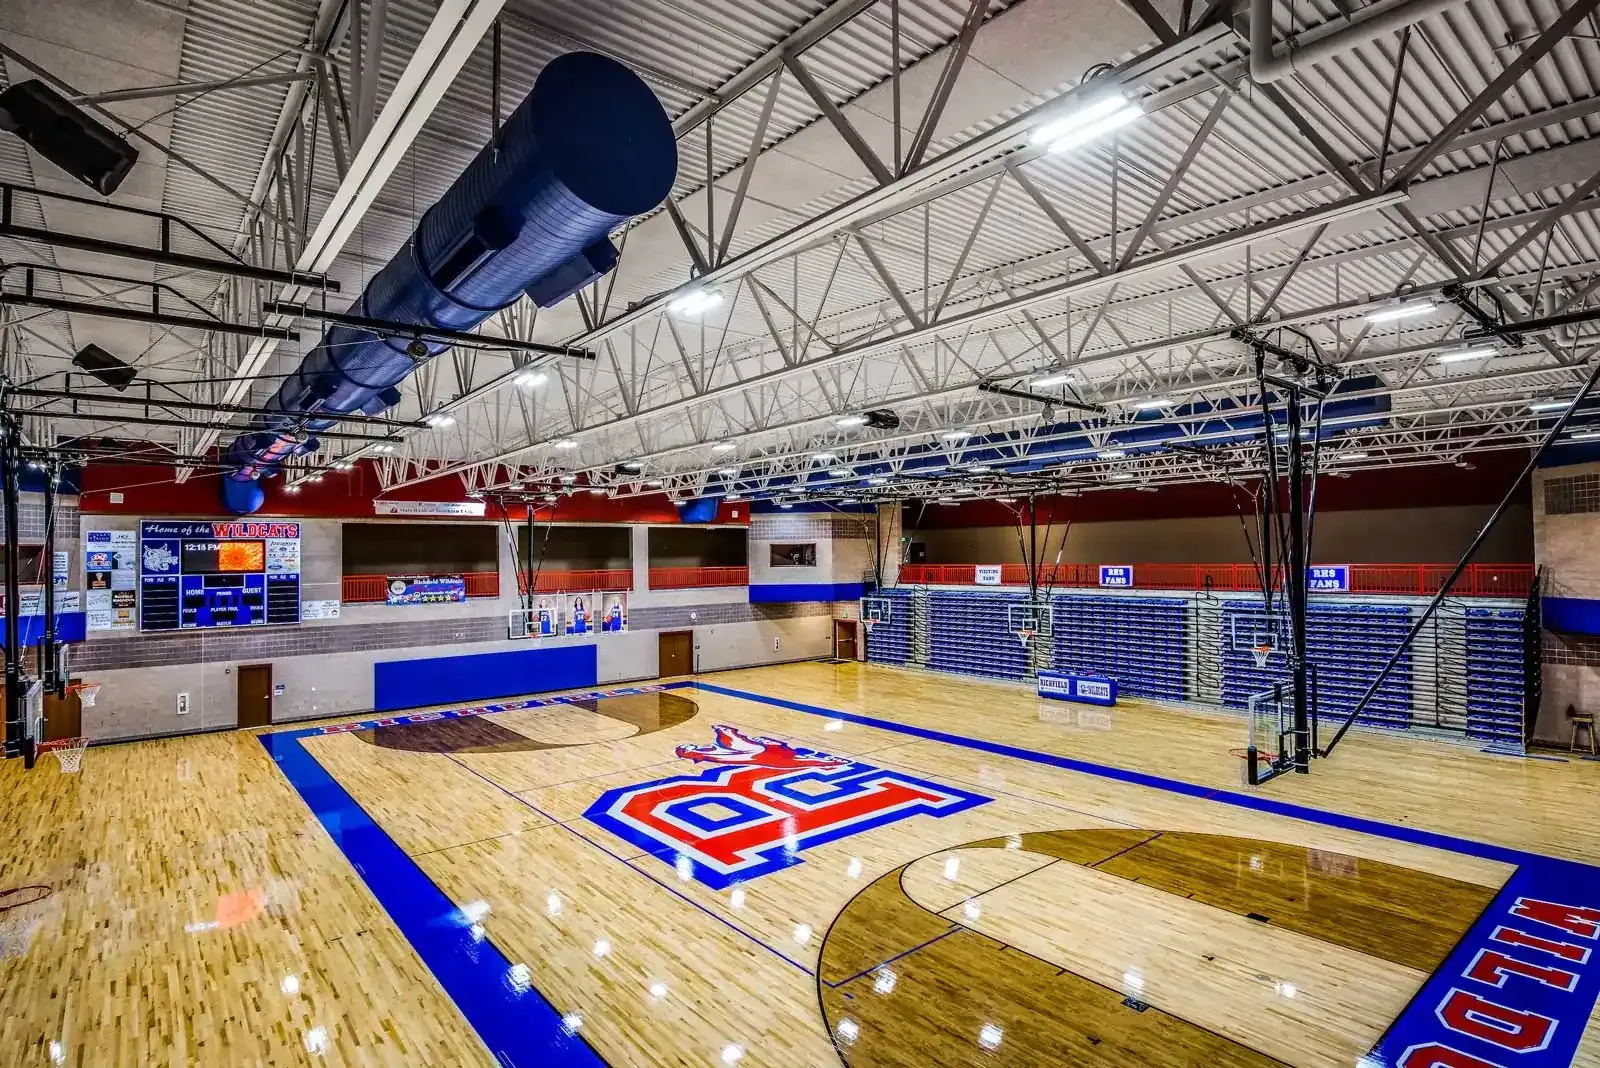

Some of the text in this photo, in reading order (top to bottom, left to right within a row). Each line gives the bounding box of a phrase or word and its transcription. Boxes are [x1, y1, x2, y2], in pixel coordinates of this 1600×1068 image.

[144, 522, 298, 538] Home of the WILDCATS
[1108, 568, 1124, 576] RHS
[1313, 570, 1336, 578] RHS
[1310, 580, 1340, 588] FANS
[1040, 679, 1068, 689] RICHFIELD
